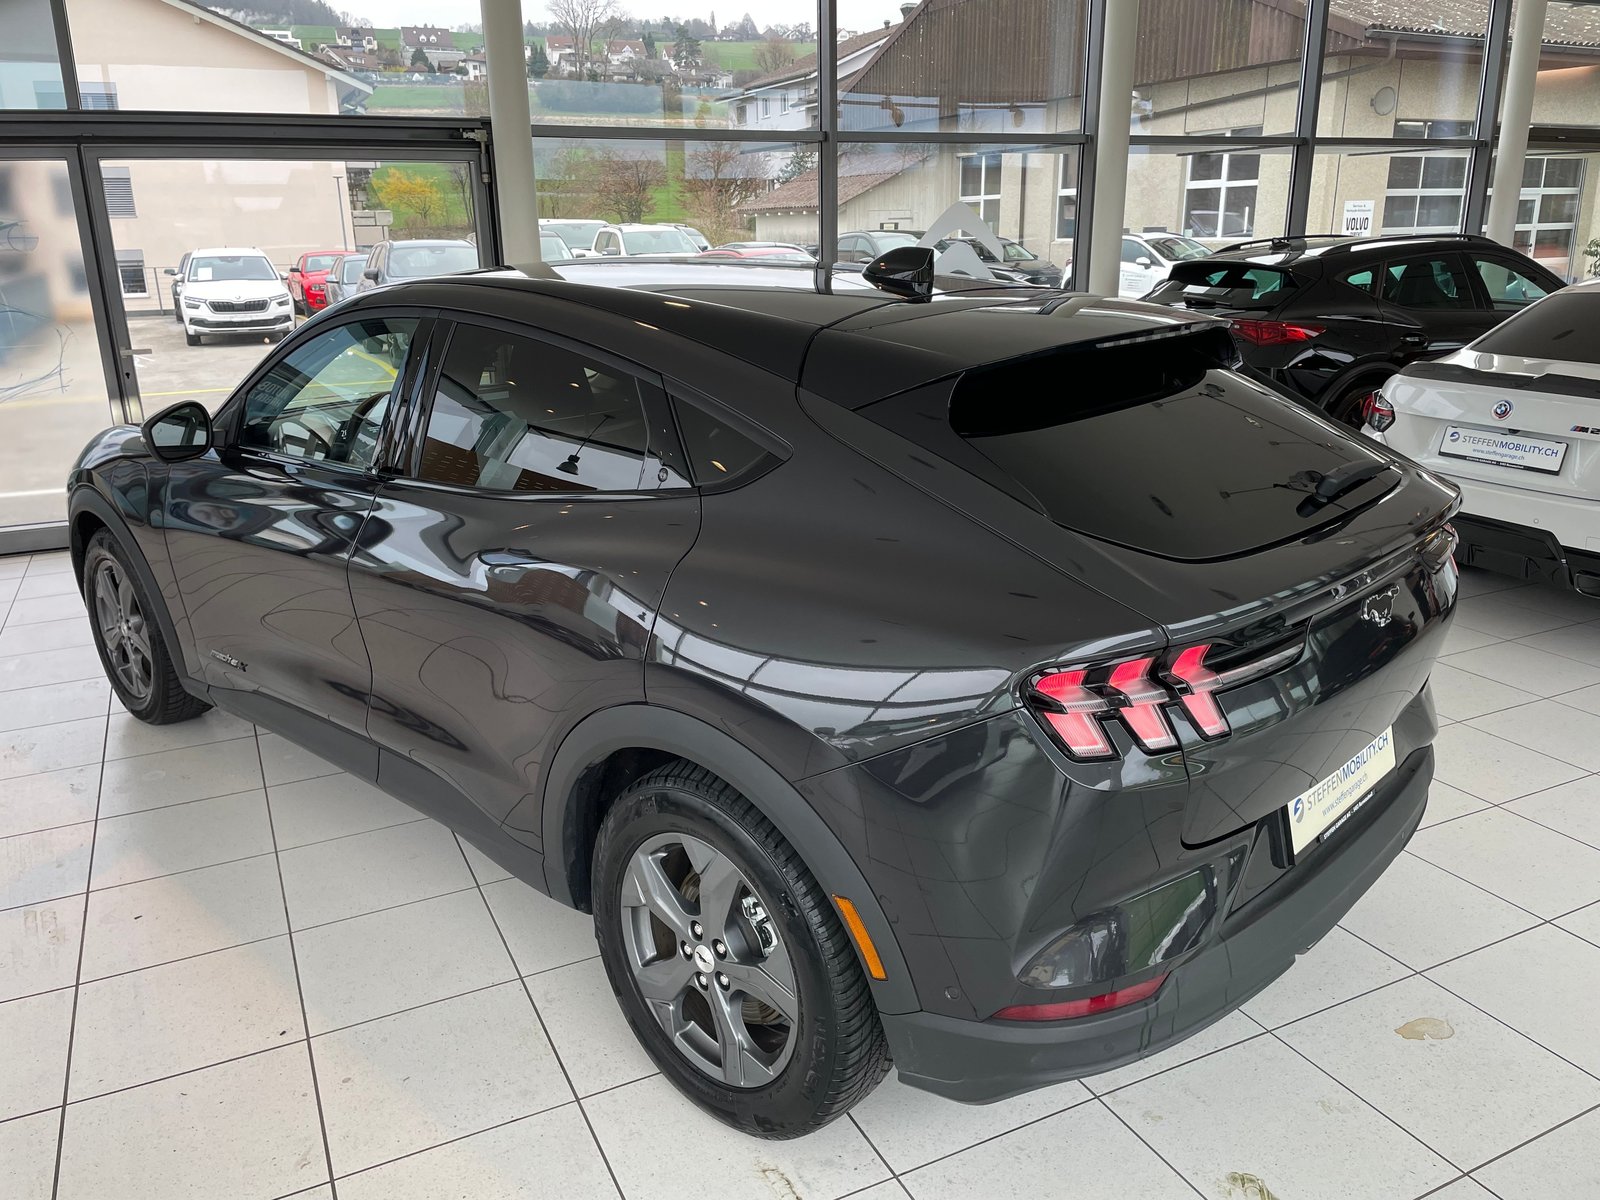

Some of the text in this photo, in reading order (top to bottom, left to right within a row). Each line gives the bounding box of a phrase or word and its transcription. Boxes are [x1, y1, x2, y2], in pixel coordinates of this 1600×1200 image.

[1345, 217, 1369, 231] VOLVO
[1462, 435, 1559, 458] STEFFENMOBILITY.CH
[1472, 447, 1525, 461] www.steffengarage.ch
[1307, 732, 1389, 811] STEFFENMOBILITY.CH
